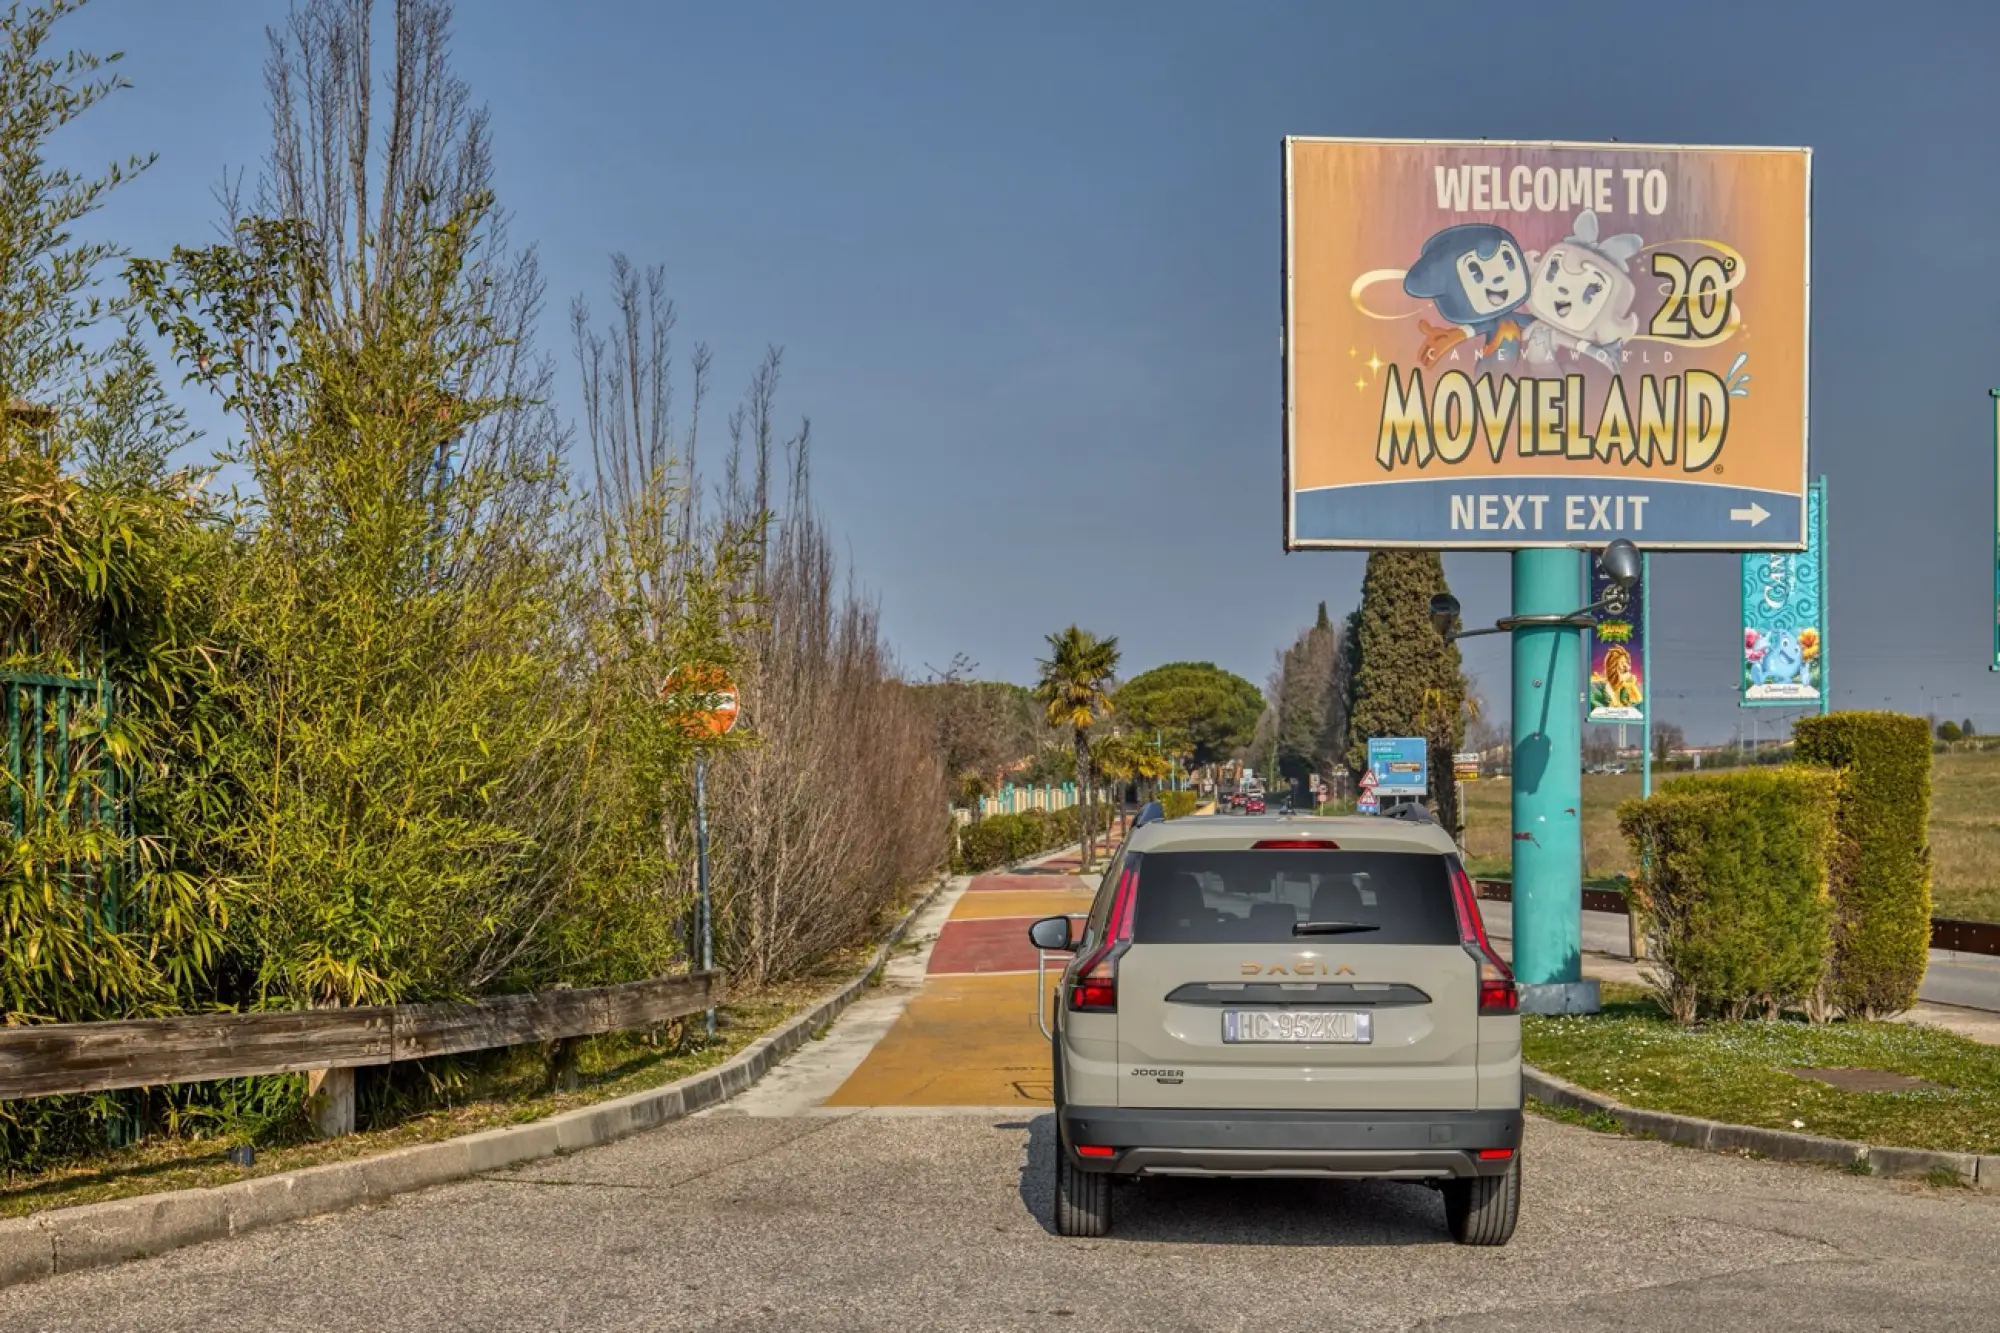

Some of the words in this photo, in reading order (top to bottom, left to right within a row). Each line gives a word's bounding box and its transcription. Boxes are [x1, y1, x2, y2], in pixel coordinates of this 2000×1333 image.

[1435, 166, 1613, 214] WELCOME
[1623, 169, 1667, 215] TO
[1376, 364, 1730, 473] MOVIELAND
[1451, 495, 1549, 530] NEXT
[1565, 496, 1650, 530] EXIT
[1764, 552, 1787, 608] CAN
[1240, 963, 1356, 976] DACIA
[1131, 1068, 1184, 1077] JOGGER
